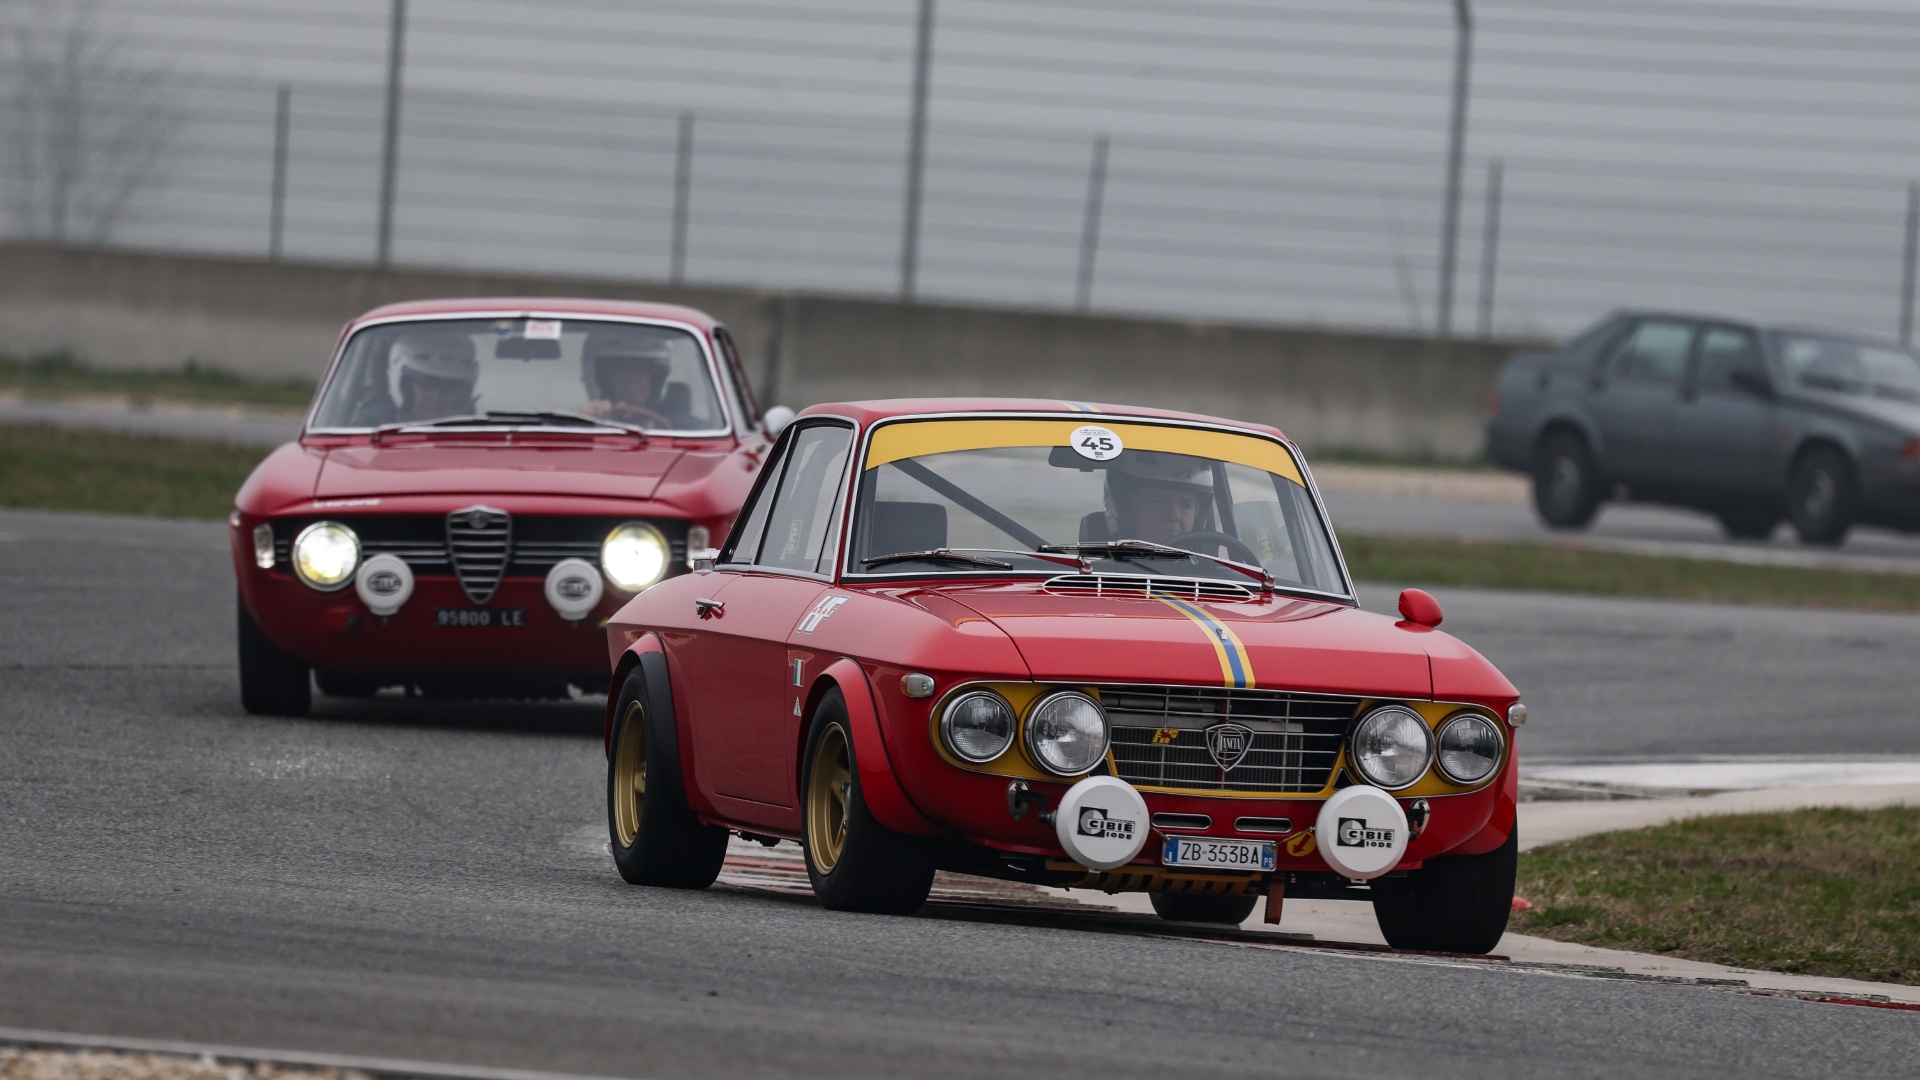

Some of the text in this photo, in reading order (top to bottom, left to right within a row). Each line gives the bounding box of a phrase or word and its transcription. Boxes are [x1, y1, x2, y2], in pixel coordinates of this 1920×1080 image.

[1080, 437, 1114, 451] 45
[437, 610, 525, 627] 95800 LE
[1219, 735, 1241, 752] LANCIA
[1106, 831, 1133, 840] IODE
[1366, 841, 1393, 849] IODE
[1208, 844, 1260, 865] 353BA
